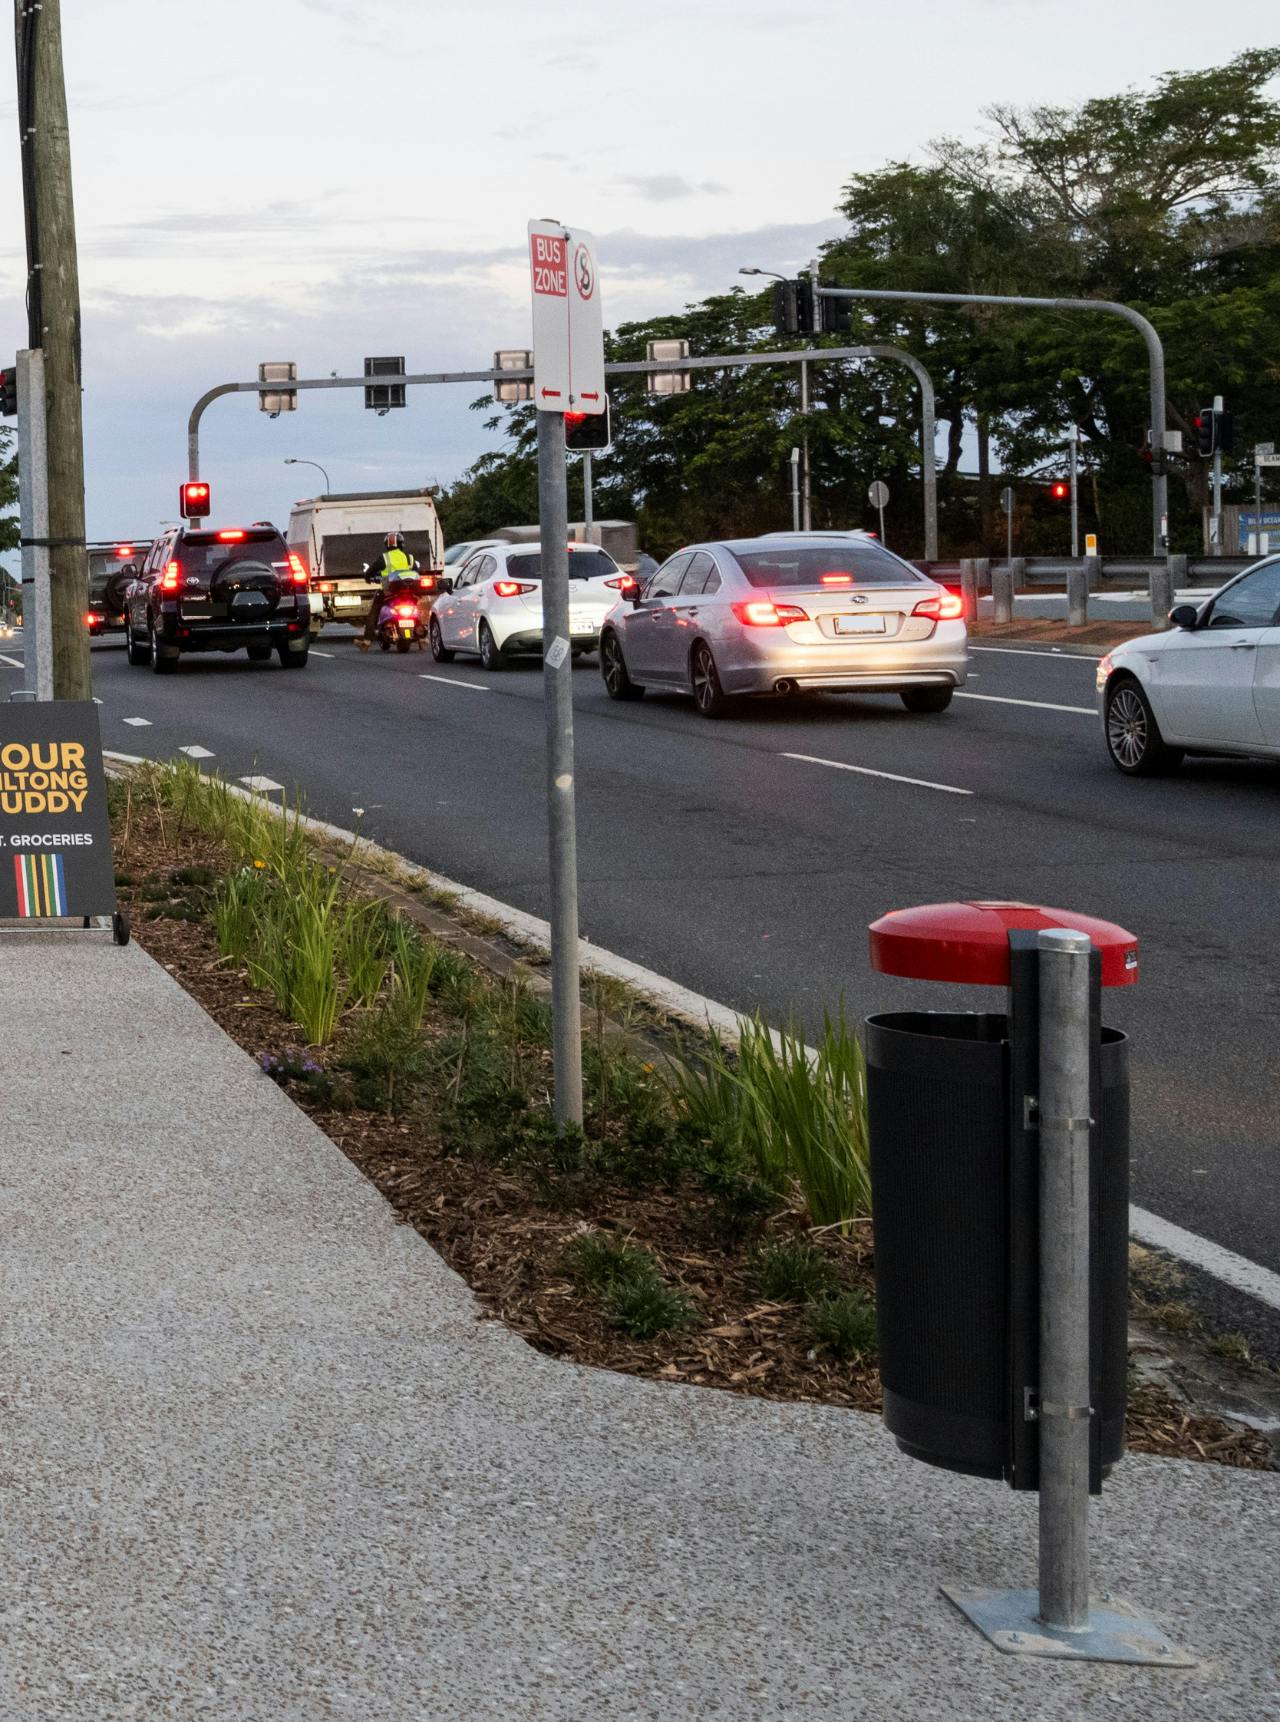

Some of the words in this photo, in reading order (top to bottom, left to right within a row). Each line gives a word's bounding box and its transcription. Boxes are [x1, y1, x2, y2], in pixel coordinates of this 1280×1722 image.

[536, 238, 561, 263] BUS
[534, 266, 566, 294] ZONE
[10, 833, 93, 847] GROCERIES
